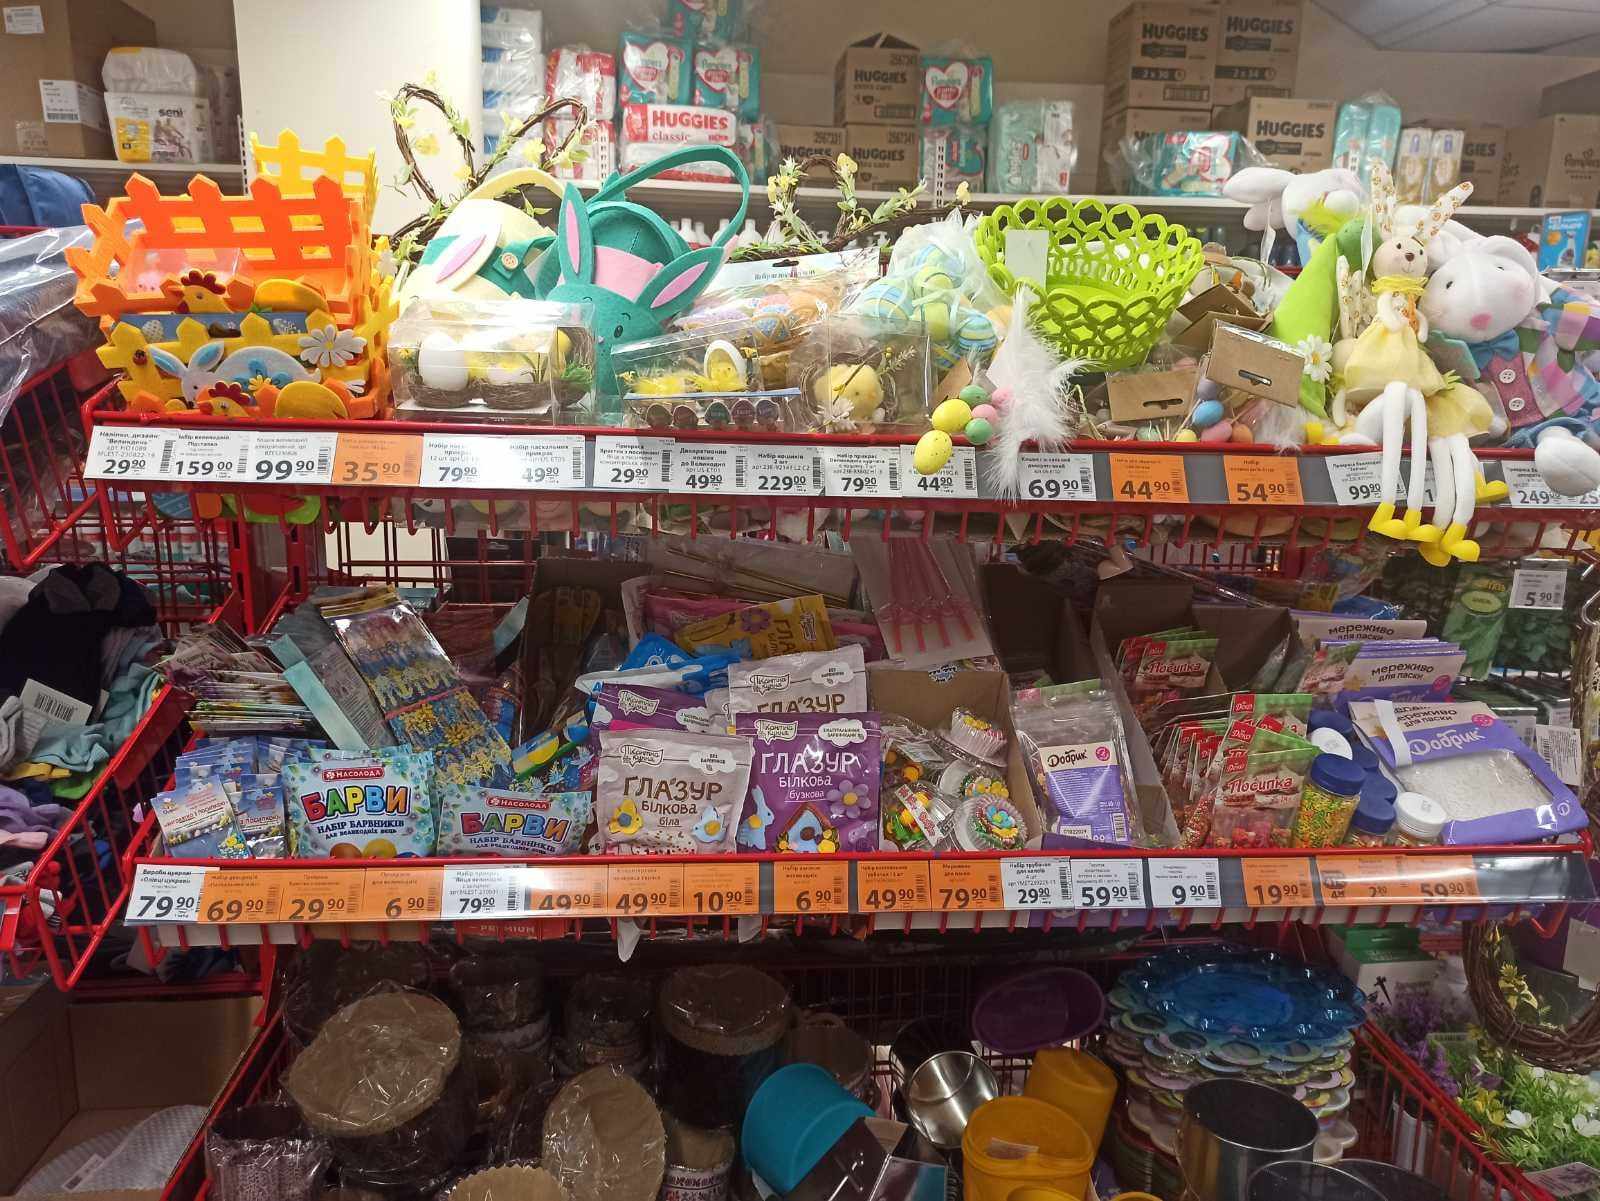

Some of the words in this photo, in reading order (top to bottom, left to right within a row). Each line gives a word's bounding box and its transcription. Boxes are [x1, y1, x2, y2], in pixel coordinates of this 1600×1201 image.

[1142, 24, 1208, 42] HUGGIES
[1227, 16, 1293, 33] HUGGIES
[854, 70, 907, 83] HUGGIES
[652, 110, 728, 130] HUGGIES
[652, 131, 690, 141] classic
[1256, 120, 1325, 138] HUGGIES
[853, 147, 905, 161] HUGGIES
[102, 459, 130, 474] 29
[132, 460, 146, 468] 90
[175, 460, 214, 475] 159
[217, 461, 233, 470] 00
[255, 460, 292, 480] 99
[296, 461, 314, 471] 90
[343, 461, 379, 482] 35
[382, 463, 400, 474] 90
[439, 467, 463, 482] 79
[464, 467, 477, 475] 90
[546, 467, 559, 475] 90
[611, 468, 634, 483] 29
[686, 475, 709, 489] 49
[758, 476, 793, 490] 229
[793, 476, 806, 484] 00
[918, 477, 940, 491] 44
[940, 477, 952, 485] 90
[841, 477, 864, 492] 79
[1028, 479, 1060, 498] 69
[1062, 480, 1078, 489] 90
[1120, 480, 1152, 499] 44
[1154, 482, 1170, 491] 90
[1236, 483, 1268, 501] 54
[1268, 484, 1285, 493] 90
[1349, 485, 1370, 500] 99
[1370, 483, 1381, 491] 90
[1518, 490, 1550, 504] 249
[1525, 592, 1536, 606] 5
[1328, 623, 1394, 636] мереживо
[1371, 662, 1434, 676] мереживо
[1408, 729, 1485, 756] Добрик
[760, 752, 856, 774] ГЛАЗУР
[1047, 749, 1088, 767] Добрик
[336, 770, 381, 778] НАСОЛОДА
[623, 776, 723, 801] ГЛАЗУР
[1228, 777, 1293, 793] Посипка
[301, 785, 411, 822] БАРВИ
[501, 800, 547, 809] НАСОЛОДА
[317, 822, 347, 834] НАБІР
[350, 820, 404, 828] БАРВНИКІВ
[460, 813, 570, 842] БАРВИ
[470, 836, 500, 844] НАБІР
[574, 894, 591, 904] 90
[693, 891, 723, 912] 10
[726, 891, 742, 902] 90
[796, 890, 812, 910] 6
[815, 890, 831, 901] 90
[865, 889, 896, 909] 49
[898, 889, 914, 899] 90
[940, 888, 969, 909] 79
[972, 888, 987, 898] 90
[1018, 889, 1039, 904] 29
[1039, 888, 1049, 896] 90
[1082, 887, 1110, 906] 59
[1112, 886, 1127, 897] 90
[1172, 885, 1186, 904] 9
[1190, 885, 1205, 895] 90
[1253, 885, 1282, 905] 19
[1283, 884, 1298, 895] 90
[137, 896, 173, 917] 79
[176, 897, 194, 908] 90
[207, 899, 243, 922] 69
[246, 900, 263, 910] 90
[289, 898, 324, 920] 29
[327, 899, 346, 909] 90
[385, 897, 402, 918] 6
[408, 898, 424, 908] 90
[459, 898, 482, 913] 79
[483, 897, 495, 906] 90
[616, 893, 648, 914] 49
[651, 893, 667, 903] 90
[479, 924, 535, 933] PRMIUM
